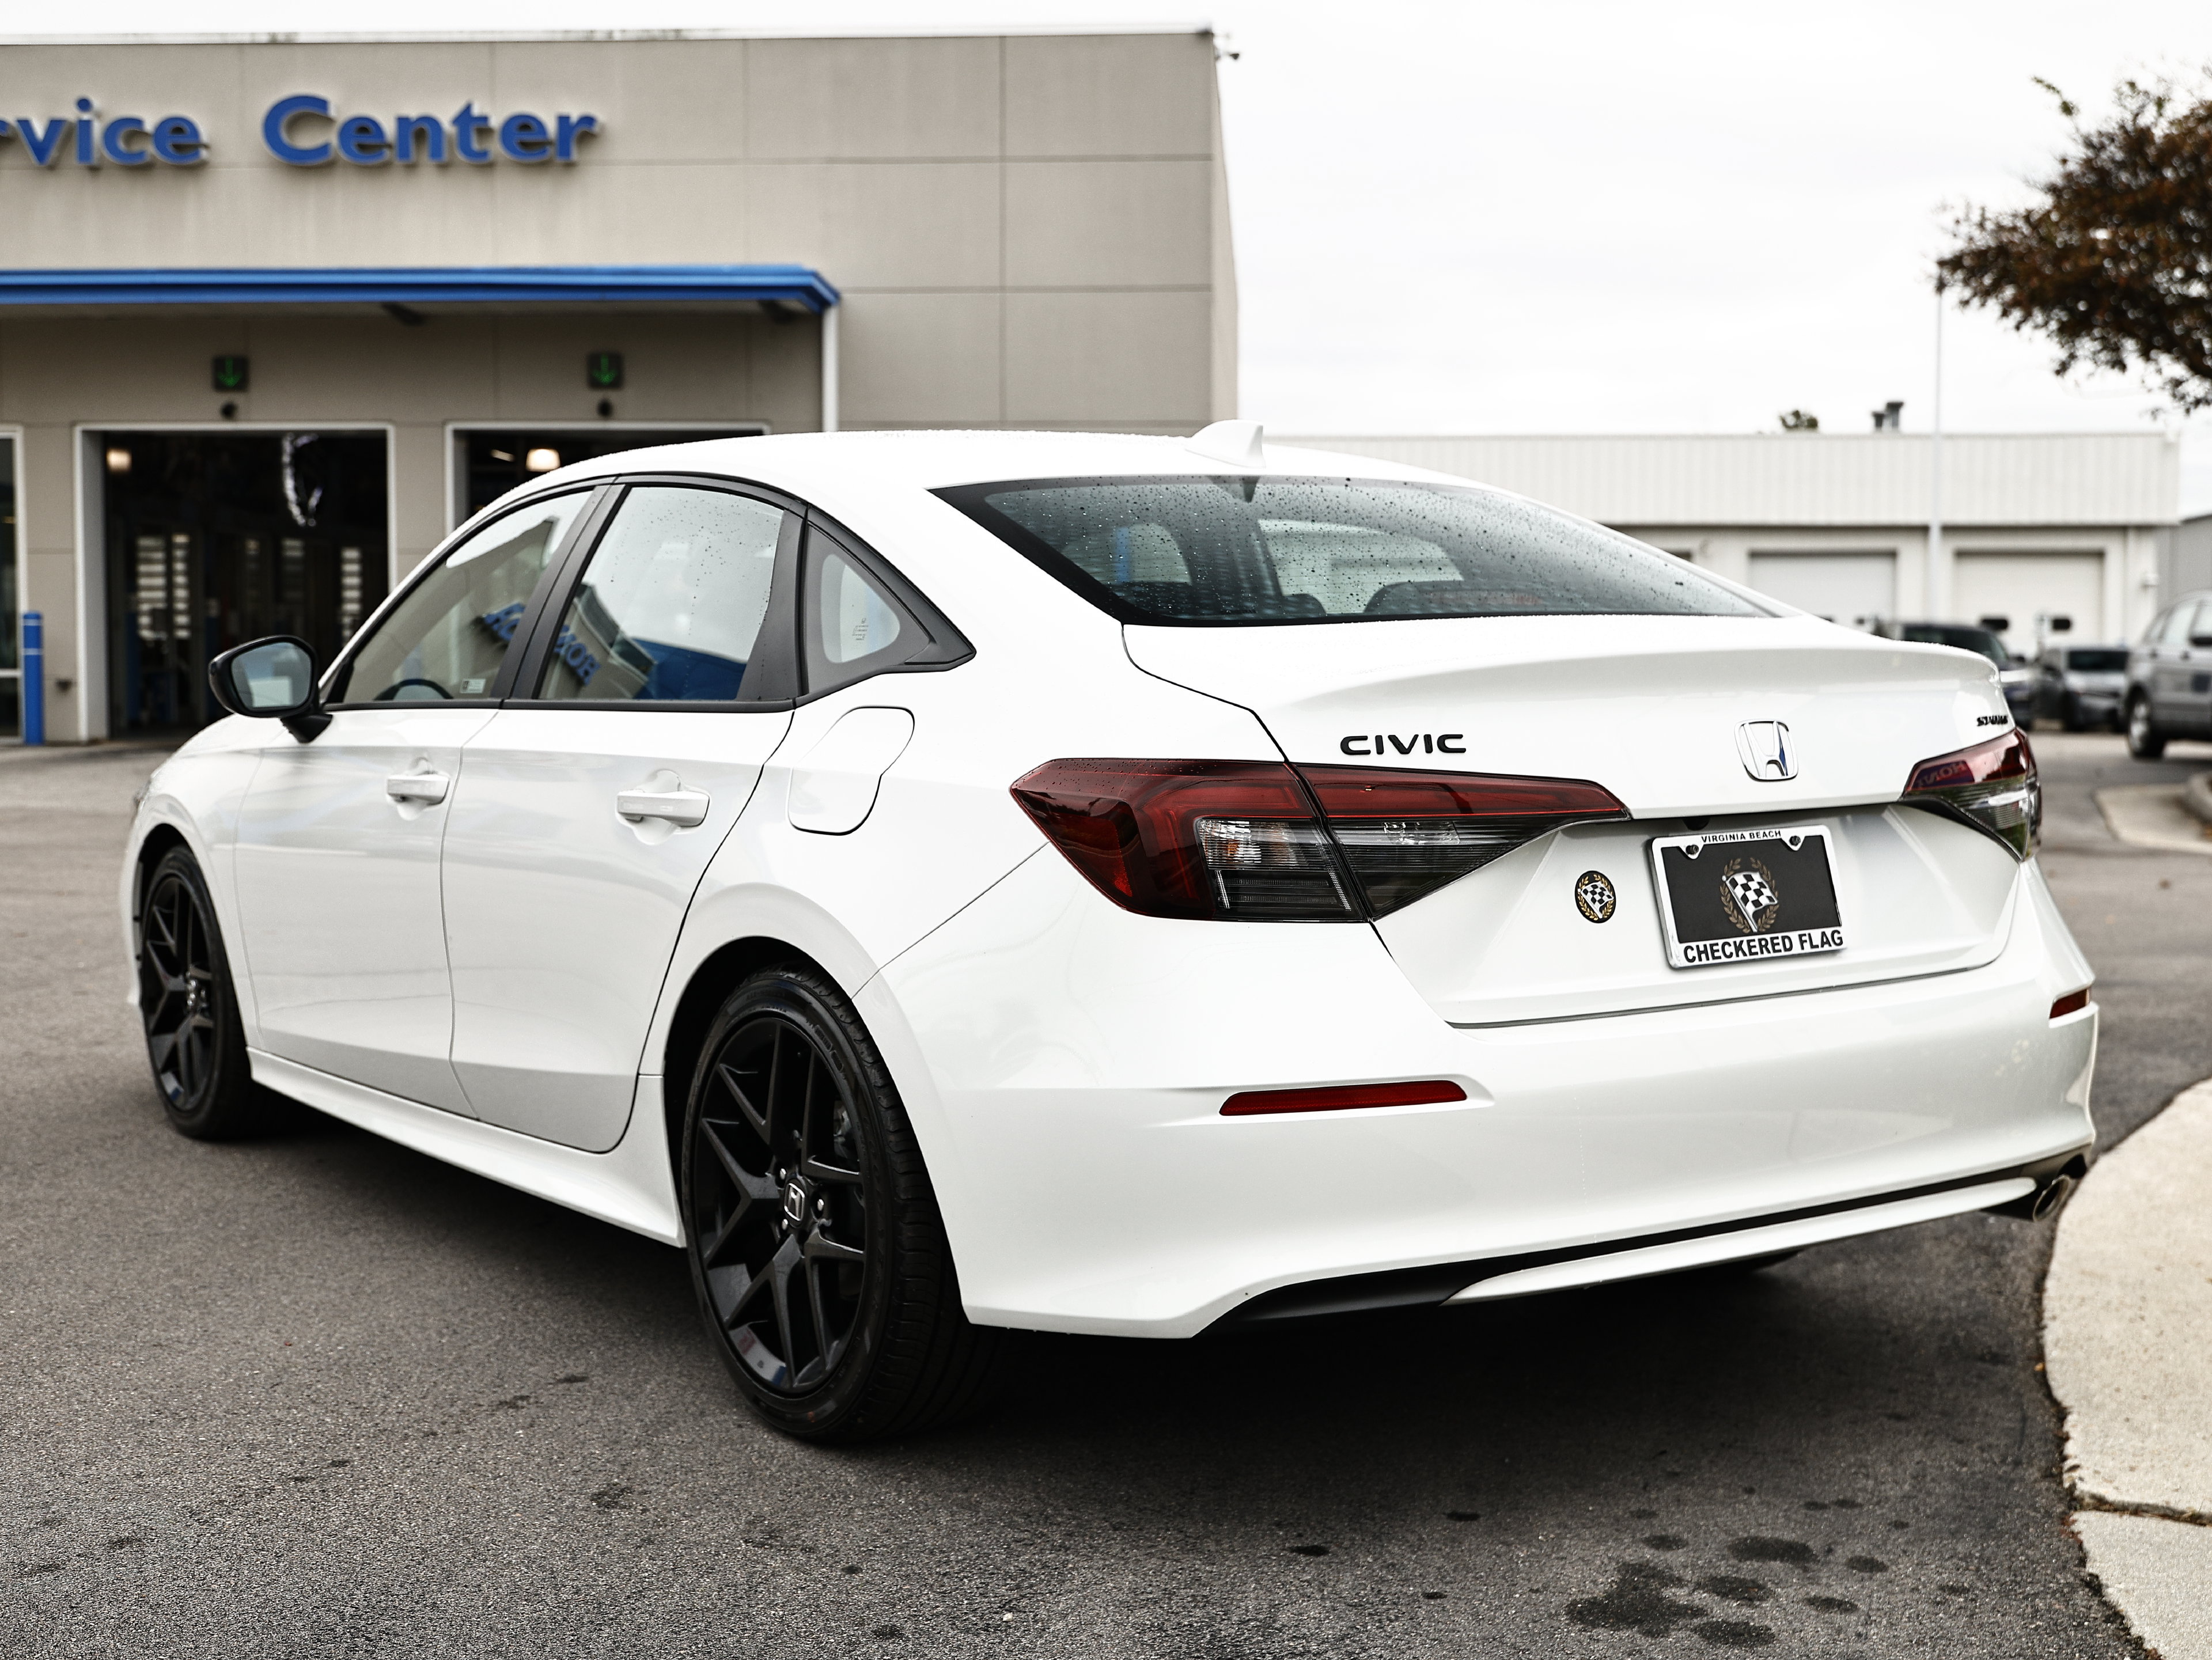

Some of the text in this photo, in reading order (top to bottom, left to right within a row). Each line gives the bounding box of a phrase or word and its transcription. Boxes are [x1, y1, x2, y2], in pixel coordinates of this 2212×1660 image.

[263, 94, 598, 165] Center
[1340, 734, 1467, 756] CIVIC
[1701, 830, 1782, 843] VIRGINIA BEACH
[1683, 930, 1843, 963] CHECKERED FLAG
